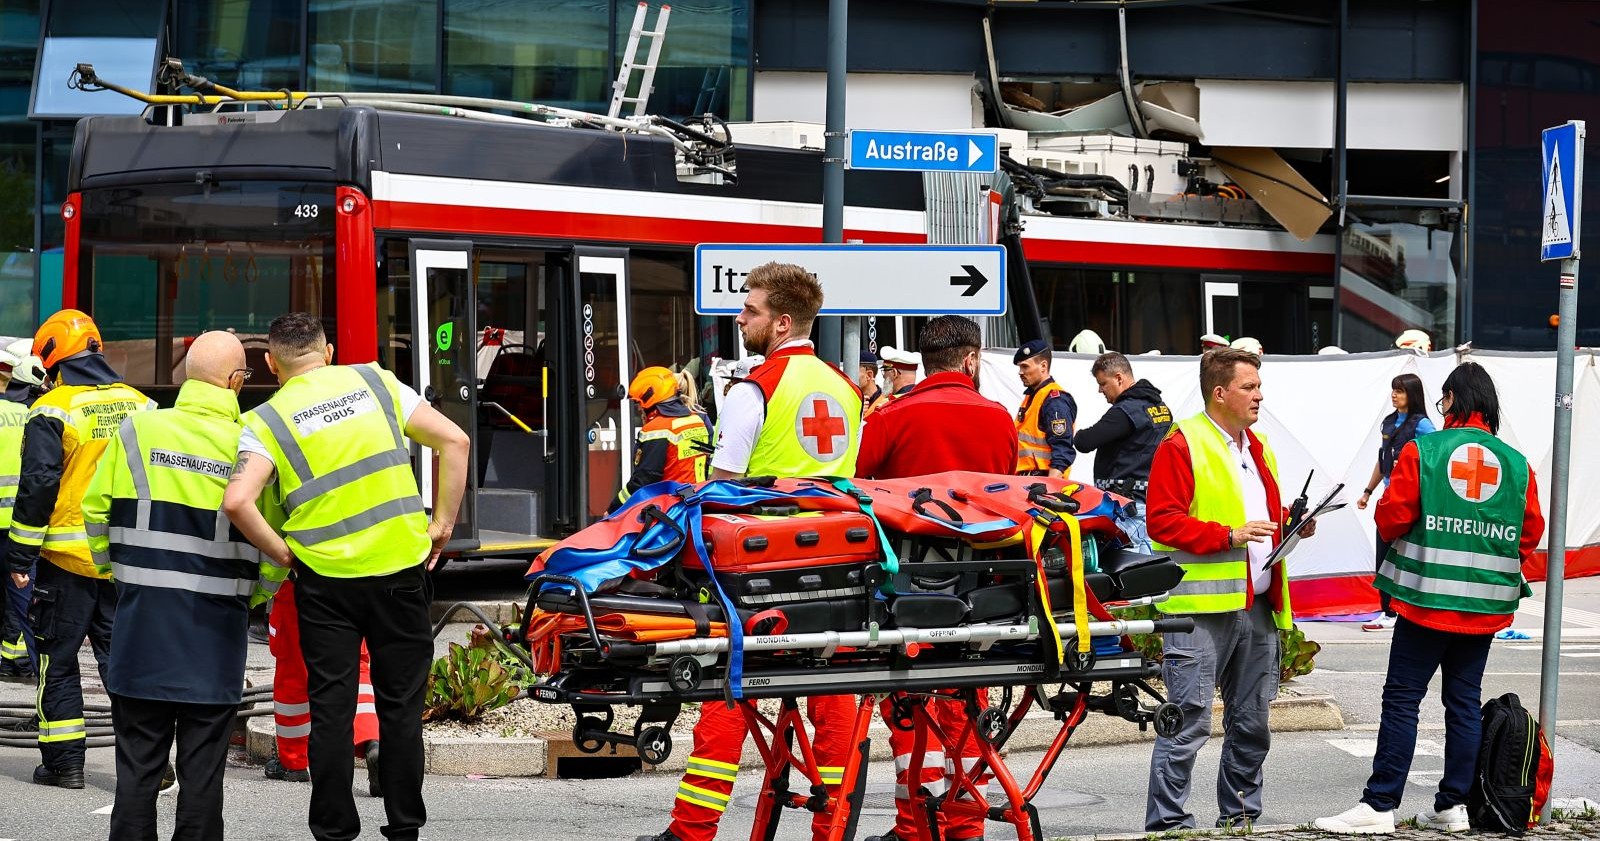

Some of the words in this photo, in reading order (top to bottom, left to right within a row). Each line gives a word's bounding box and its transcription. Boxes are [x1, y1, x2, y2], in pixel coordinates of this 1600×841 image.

[865, 138, 959, 162] Austraße
[294, 204, 319, 218] 433
[293, 390, 370, 424] STRASSENAUFSICHT
[323, 406, 355, 423] OBUS
[150, 451, 232, 477] STRASSENAUFSICHT
[1425, 514, 1518, 542] BETREUUNG
[756, 636, 790, 644] MONDIAL
[1016, 664, 1045, 672] MONDIAL
[748, 678, 771, 686] FERNO
[540, 689, 557, 700] FERNO
